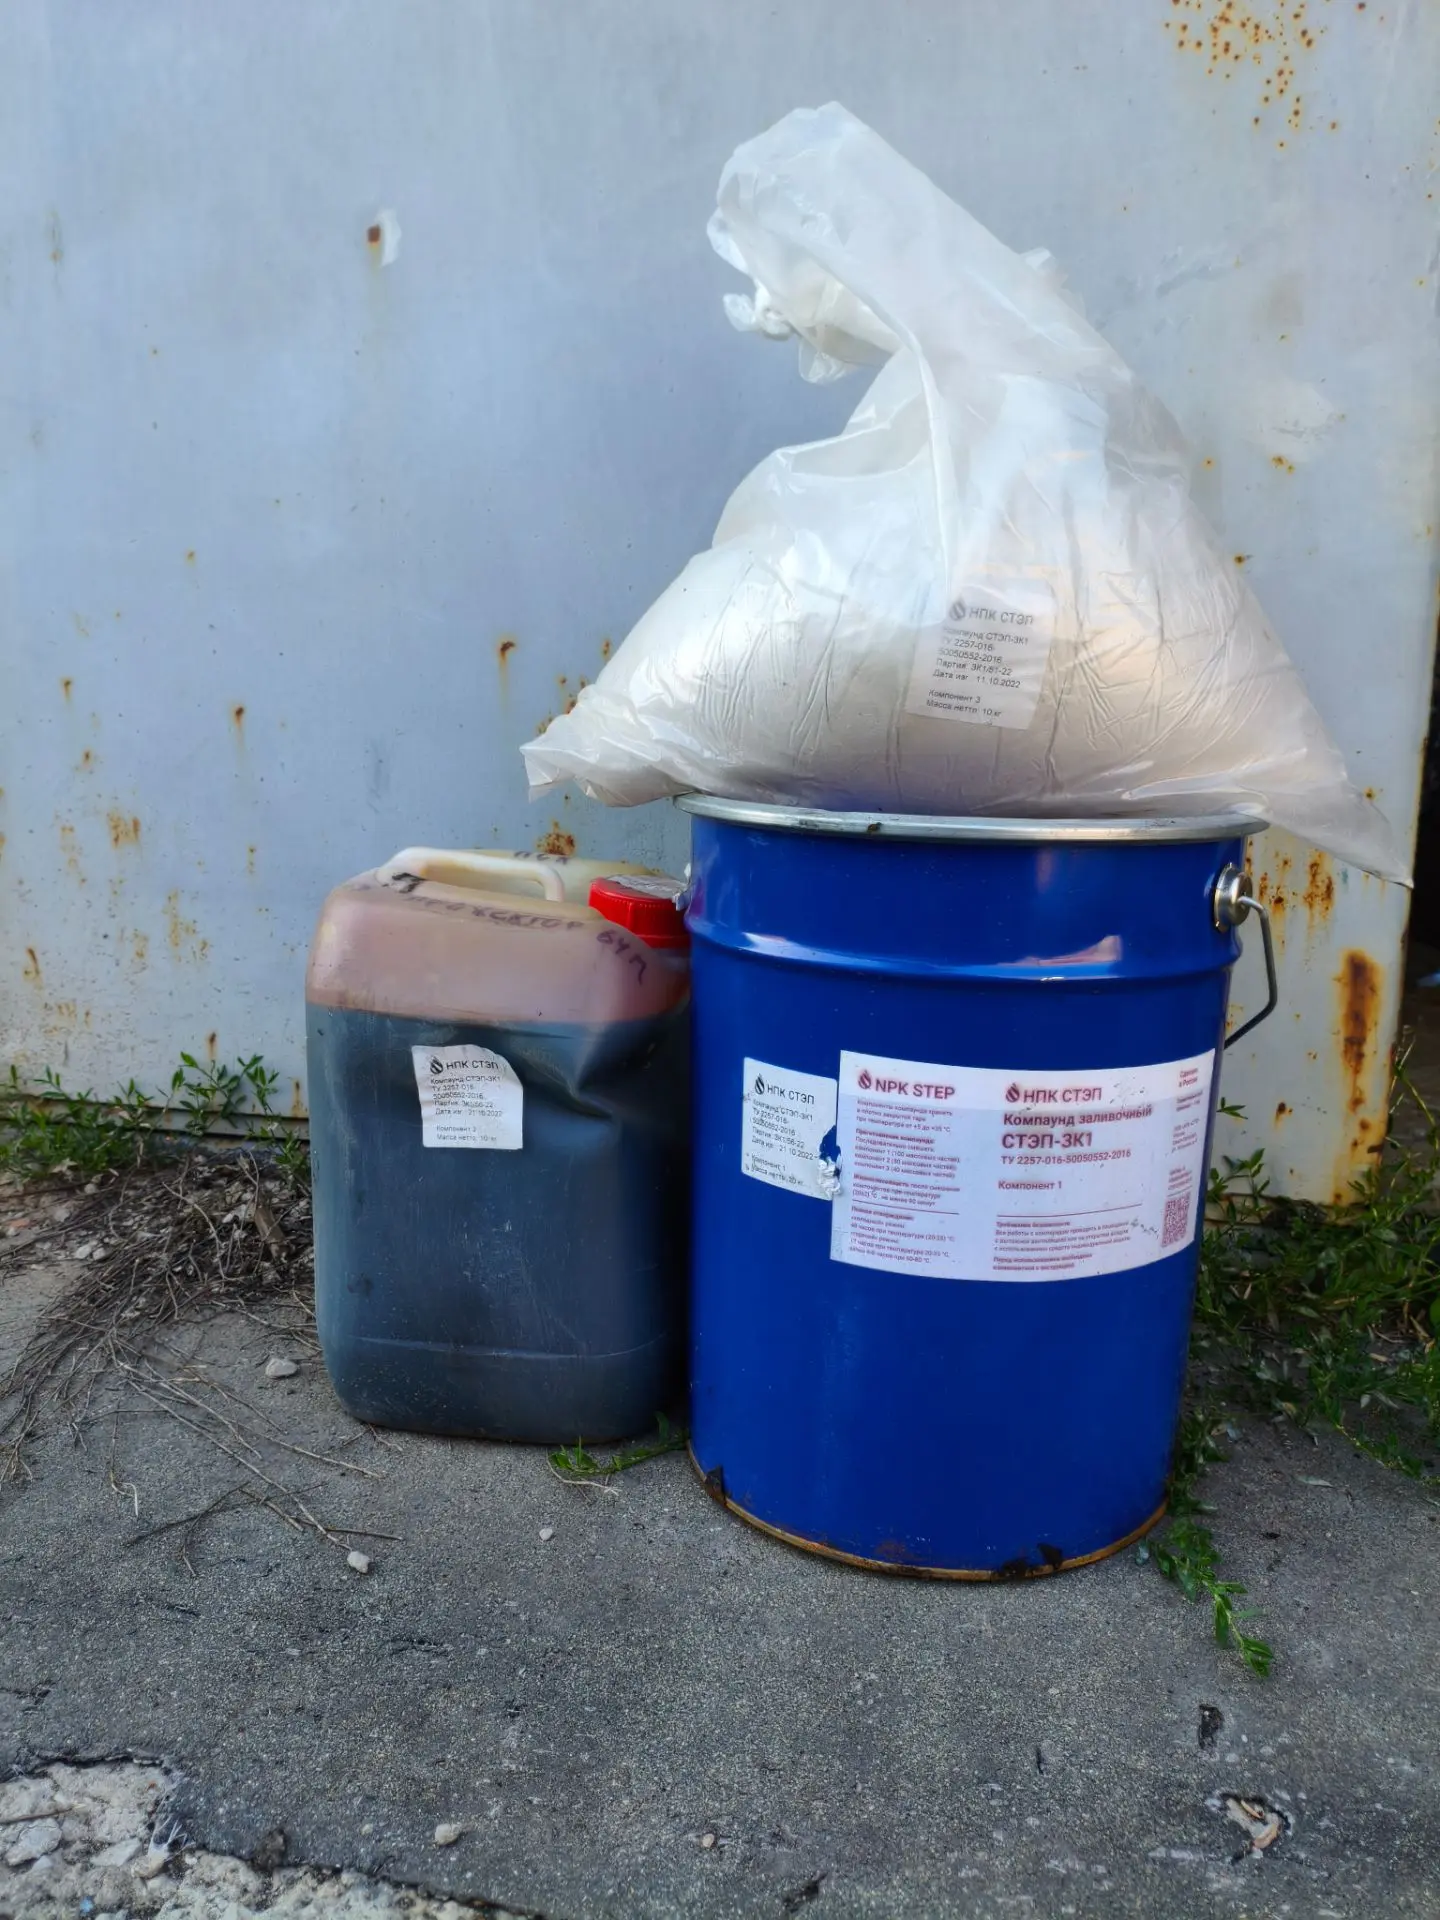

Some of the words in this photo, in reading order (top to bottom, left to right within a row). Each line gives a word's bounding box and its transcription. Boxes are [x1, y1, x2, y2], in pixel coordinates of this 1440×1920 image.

[969, 607, 997, 620] НПК
[1001, 612, 1034, 625] СТЭП
[983, 707, 993, 716] 10
[446, 1061, 469, 1070] НПК
[471, 1060, 499, 1070] СТЭП
[767, 1083, 786, 1098] НПК
[788, 1090, 815, 1105] СТЭП
[875, 1079, 908, 1095] NPK
[912, 1084, 956, 1100] STEP
[1024, 1089, 1058, 1103] НПК
[1062, 1087, 1102, 1103] СТЭП
[1003, 1113, 1075, 1128] Компаунд
[1078, 1104, 1153, 1125] заливочный
[1001, 1155, 1015, 1165] ТУ
[1017, 1149, 1132, 1165] 2257-016-50050552-2016
[998, 1181, 1055, 1190] Компонент
